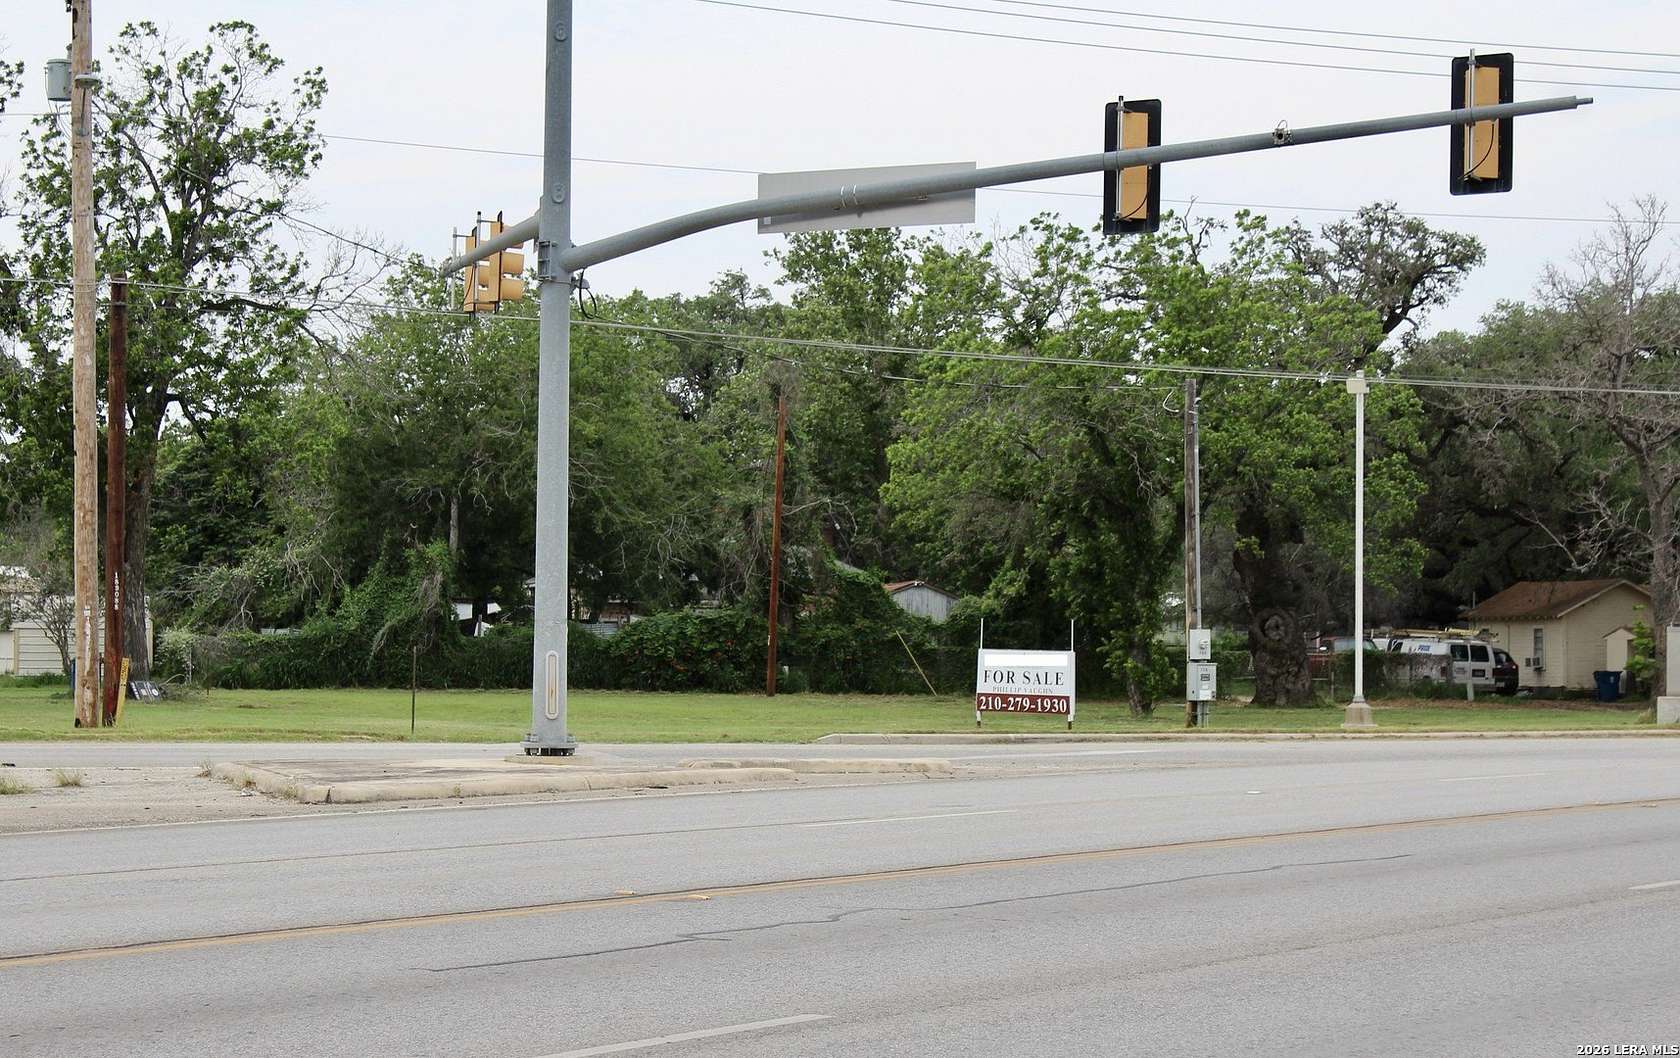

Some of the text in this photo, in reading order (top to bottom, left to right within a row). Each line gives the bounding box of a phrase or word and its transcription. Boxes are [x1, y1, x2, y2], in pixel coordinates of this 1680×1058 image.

[984, 669, 1065, 686] FOR SALE
[979, 696, 1067, 713] 210-279-1930
